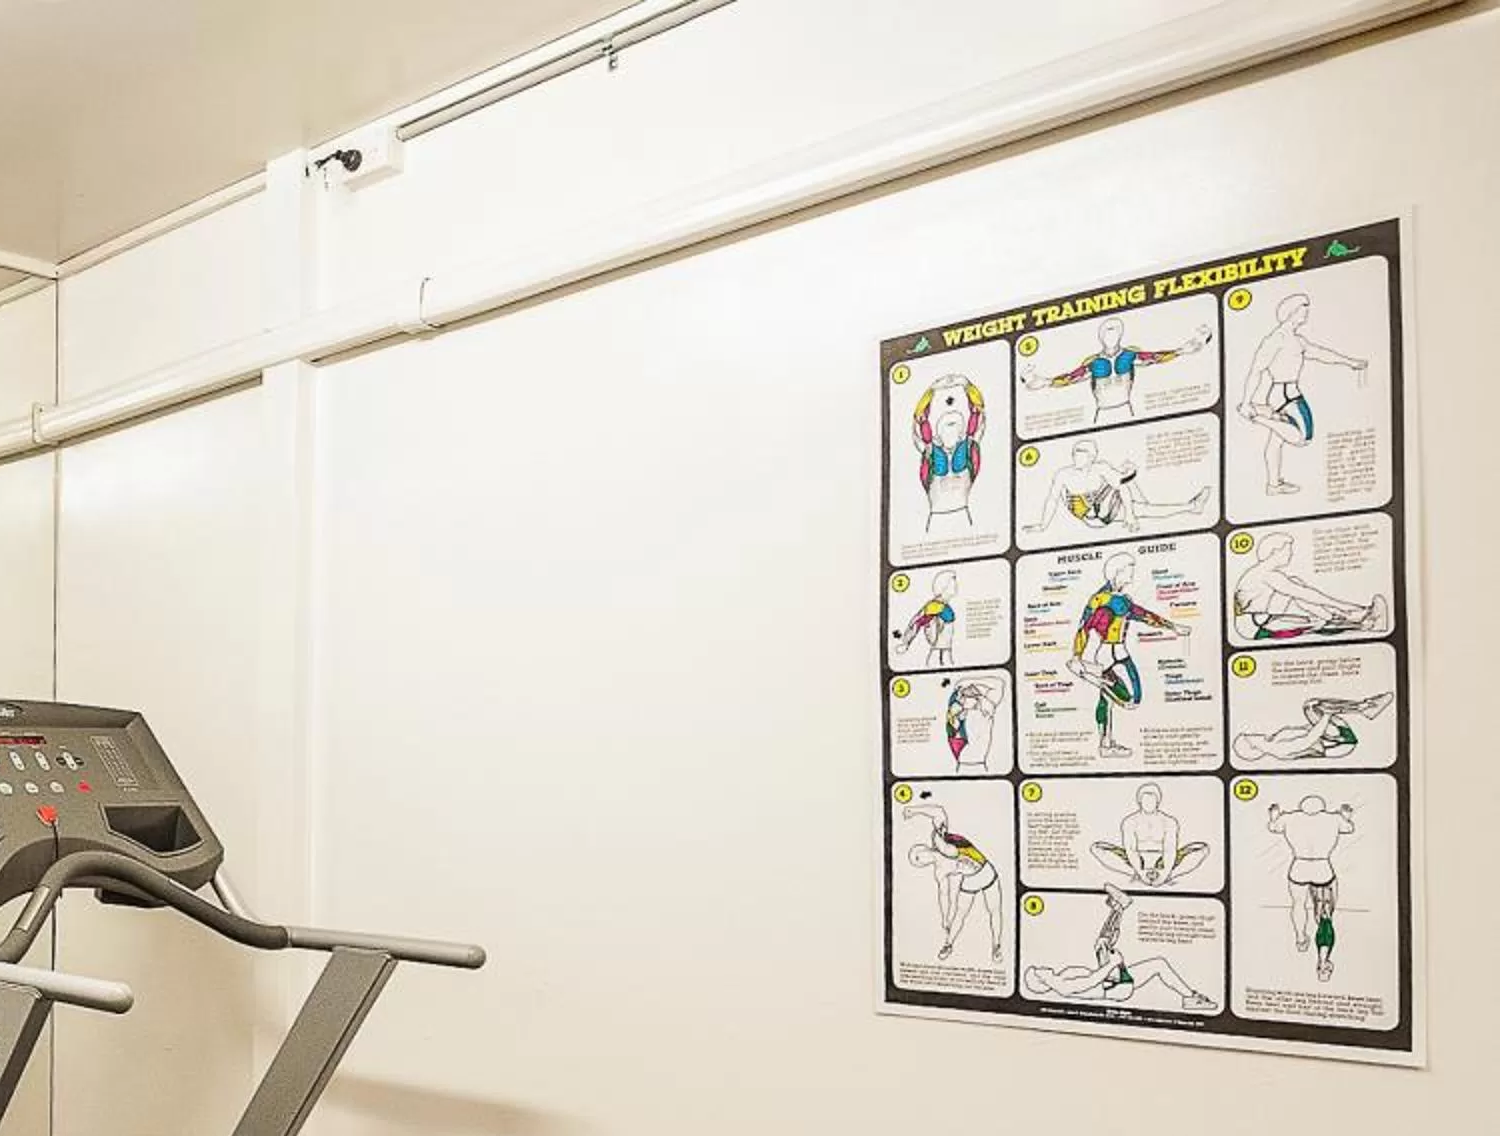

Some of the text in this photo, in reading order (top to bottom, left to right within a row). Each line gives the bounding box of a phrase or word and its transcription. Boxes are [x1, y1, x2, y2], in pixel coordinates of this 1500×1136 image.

[942, 247, 1307, 346] WEIGHT TRAINING FLEXIBILITY
[1057, 543, 1177, 565] MUSCLE GUIDE
